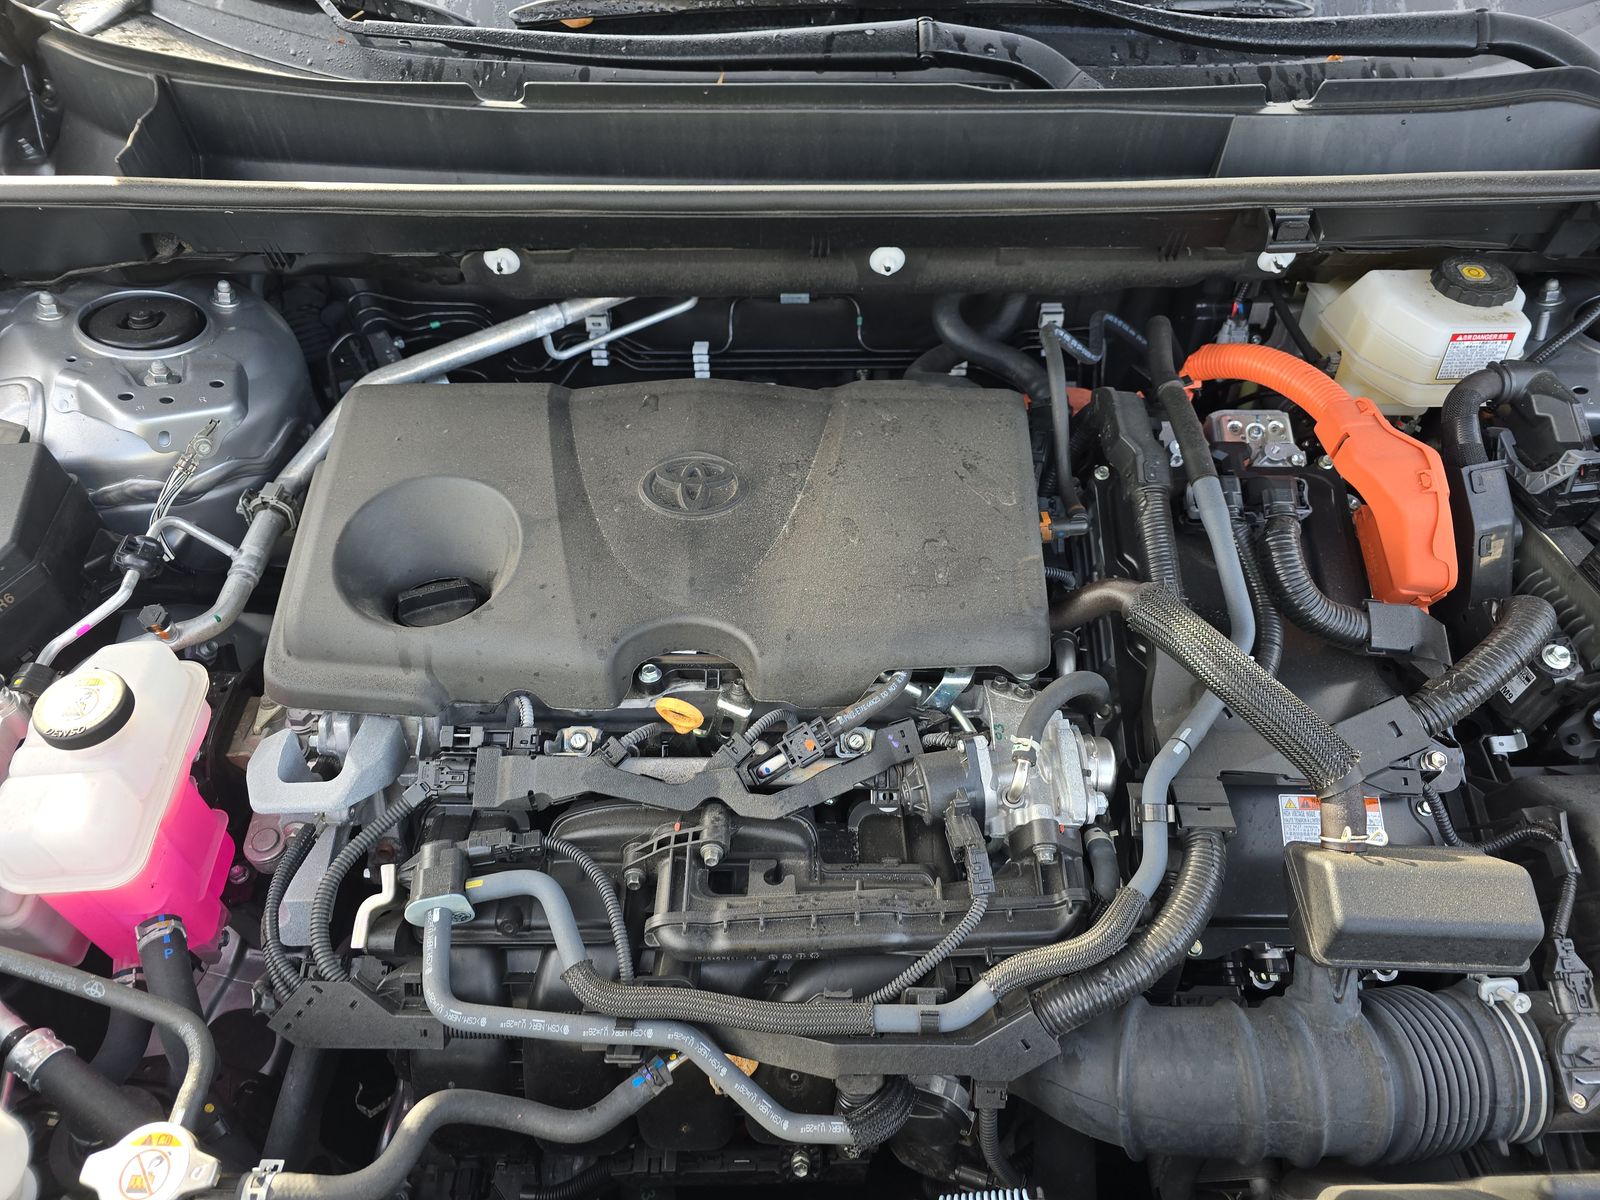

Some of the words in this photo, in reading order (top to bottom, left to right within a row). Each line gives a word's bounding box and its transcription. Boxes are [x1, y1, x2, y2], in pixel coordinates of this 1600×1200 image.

[1501, 685, 1514, 700] M9
[45, 726, 87, 738] DENSO
[164, 948, 174, 960] P
